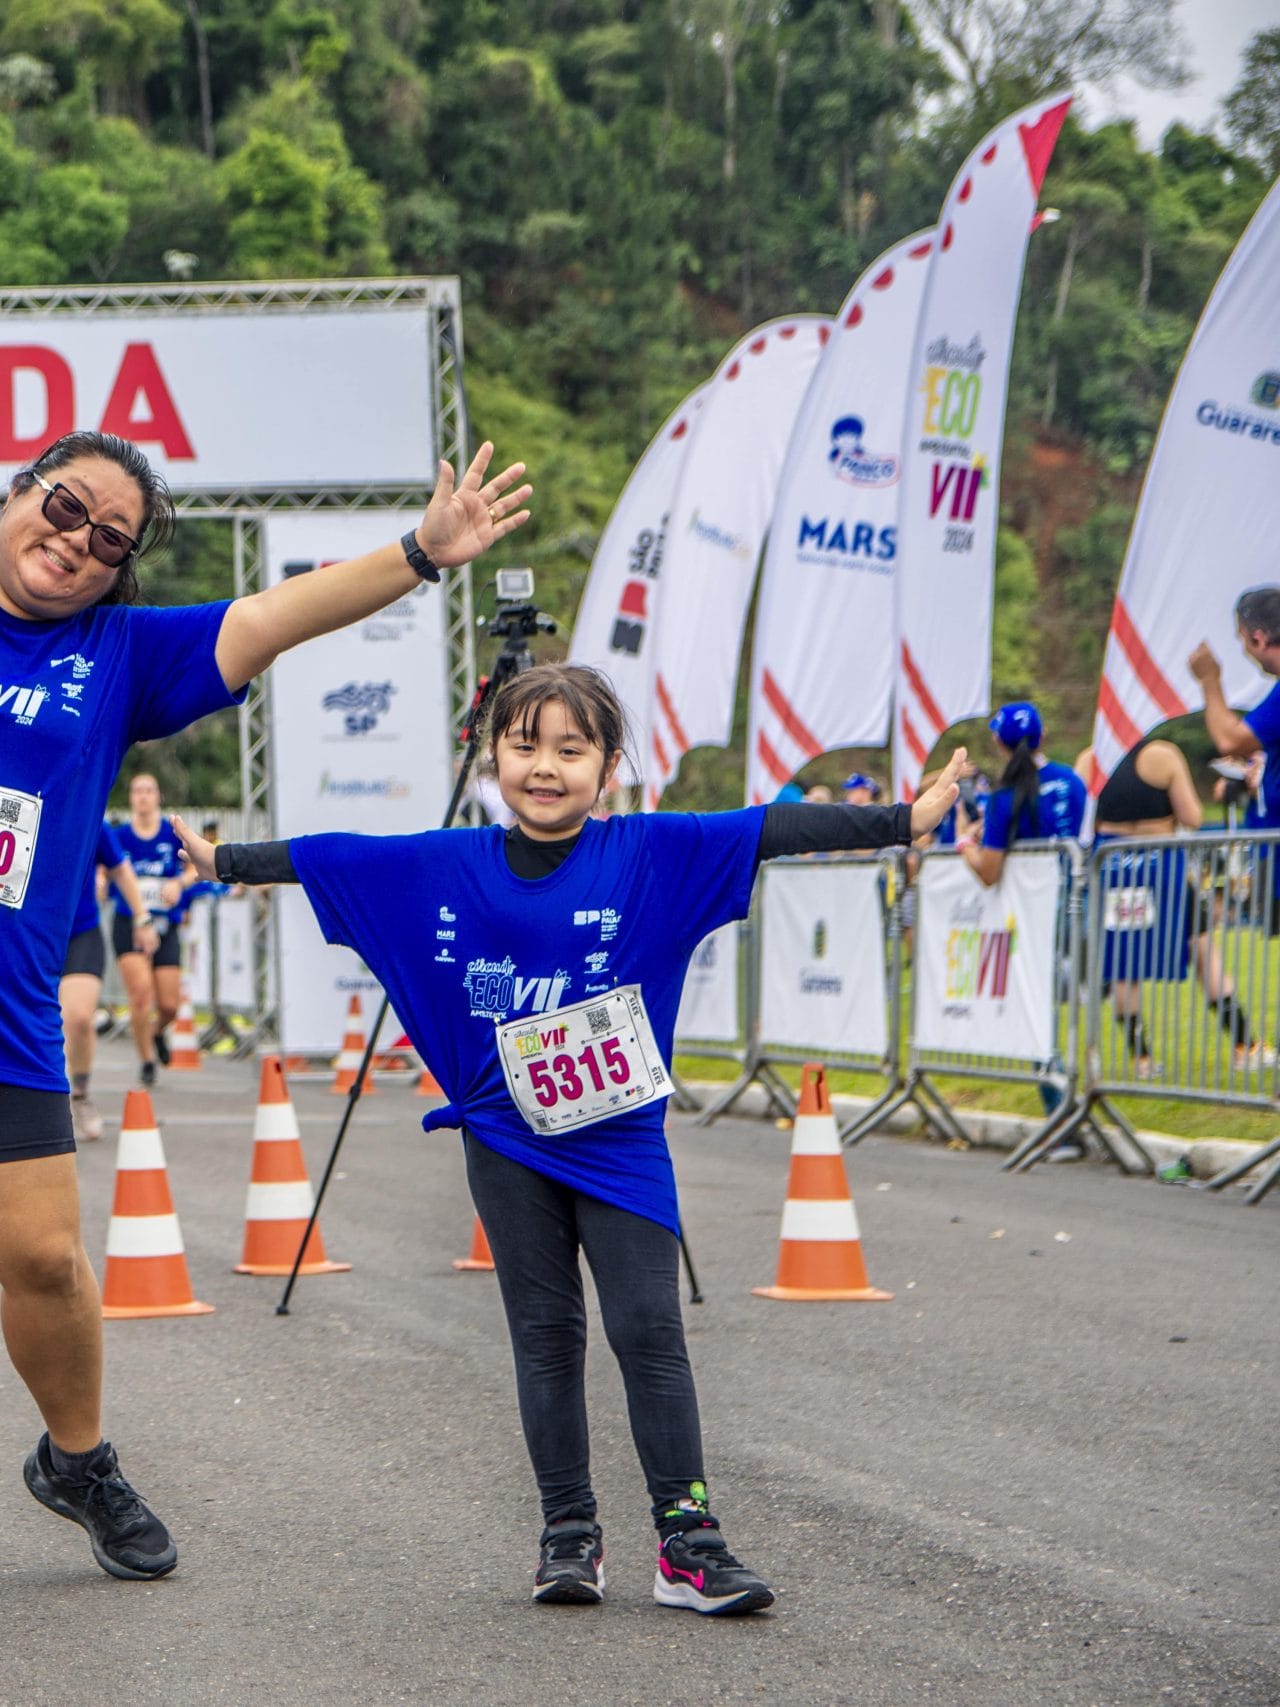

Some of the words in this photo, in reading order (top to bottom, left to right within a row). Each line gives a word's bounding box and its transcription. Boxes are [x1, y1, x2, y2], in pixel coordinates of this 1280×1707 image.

[920, 367, 981, 438] ECO
[929, 463, 984, 523] VII
[798, 514, 897, 561] MARS
[601, 908, 616, 917] SÃO
[437, 930, 455, 938] MARS
[463, 972, 515, 1010] ECO
[513, 976, 567, 1014] VII
[628, 997, 639, 1016] 5315
[515, 1033, 541, 1056] ECO
[540, 1026, 567, 1049] VII
[527, 1037, 631, 1108] 5315
[651, 1066, 662, 1085] 5315
